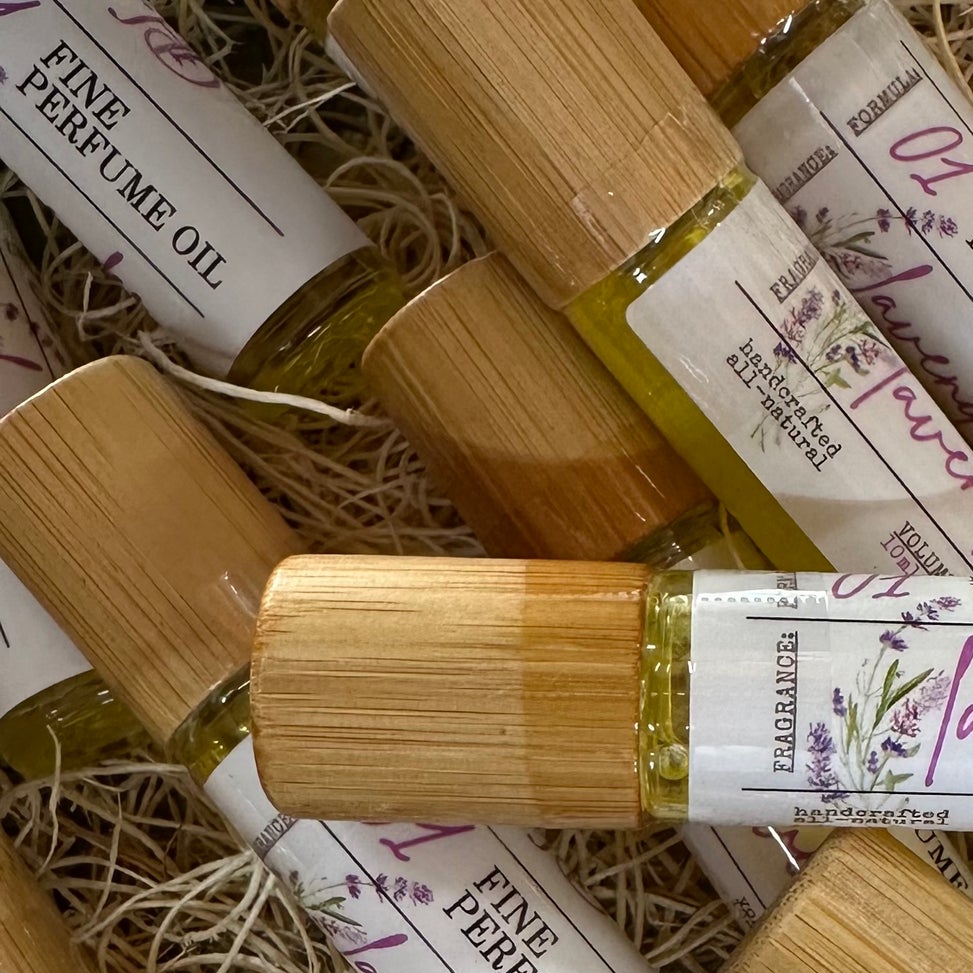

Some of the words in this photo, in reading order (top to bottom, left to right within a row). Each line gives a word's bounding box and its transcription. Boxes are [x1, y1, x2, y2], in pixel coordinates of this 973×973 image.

[39, 39, 131, 131] FINE
[845, 68, 923, 137] FORMULA:
[16, 64, 178, 231] PERFUME
[172, 223, 227, 291] OIL
[726, 354, 831, 474] all-natural
[738, 336, 842, 460] handcrafted
[893, 520, 955, 577] VOLUM
[773, 630, 798, 773] FRAGRANCE:
[793, 806, 950, 818] handcrafted
[473, 864, 560, 960] FINE
